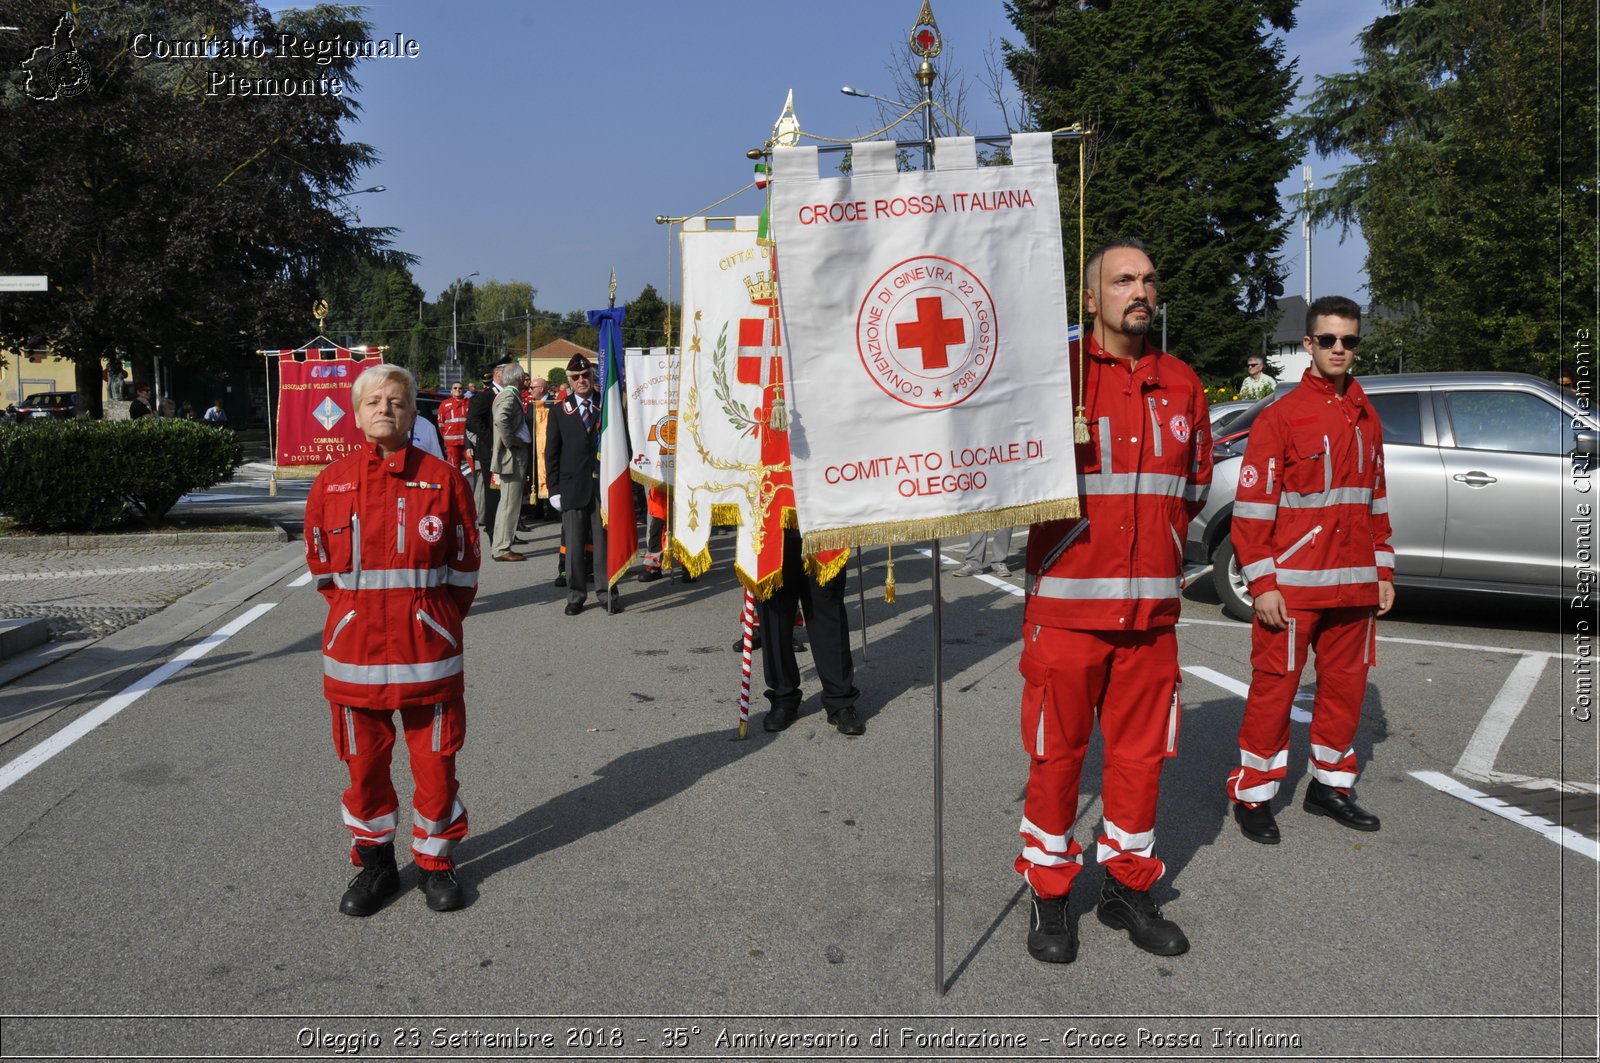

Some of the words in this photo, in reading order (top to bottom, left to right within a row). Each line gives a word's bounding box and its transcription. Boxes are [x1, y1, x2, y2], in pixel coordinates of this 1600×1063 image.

[798, 201, 869, 225] CROCE
[875, 194, 948, 219] ROSSA
[952, 189, 1035, 212] ITALIANA
[893, 266, 954, 289] GINEVRA
[958, 280, 974, 297] 22
[877, 287, 893, 304] DI
[972, 299, 990, 366] AGOSTO
[867, 306, 923, 397] CONVENZIONE
[311, 364, 347, 378] AVIS
[952, 369, 977, 393] 1864
[300, 443, 362, 453] OLEGGIO
[313, 436, 345, 444] COMUNALE
[824, 452, 943, 484] COMITATO
[950, 443, 1020, 469] LOCALE
[1026, 439, 1043, 458] DI
[897, 471, 988, 498] OLEGGIO
